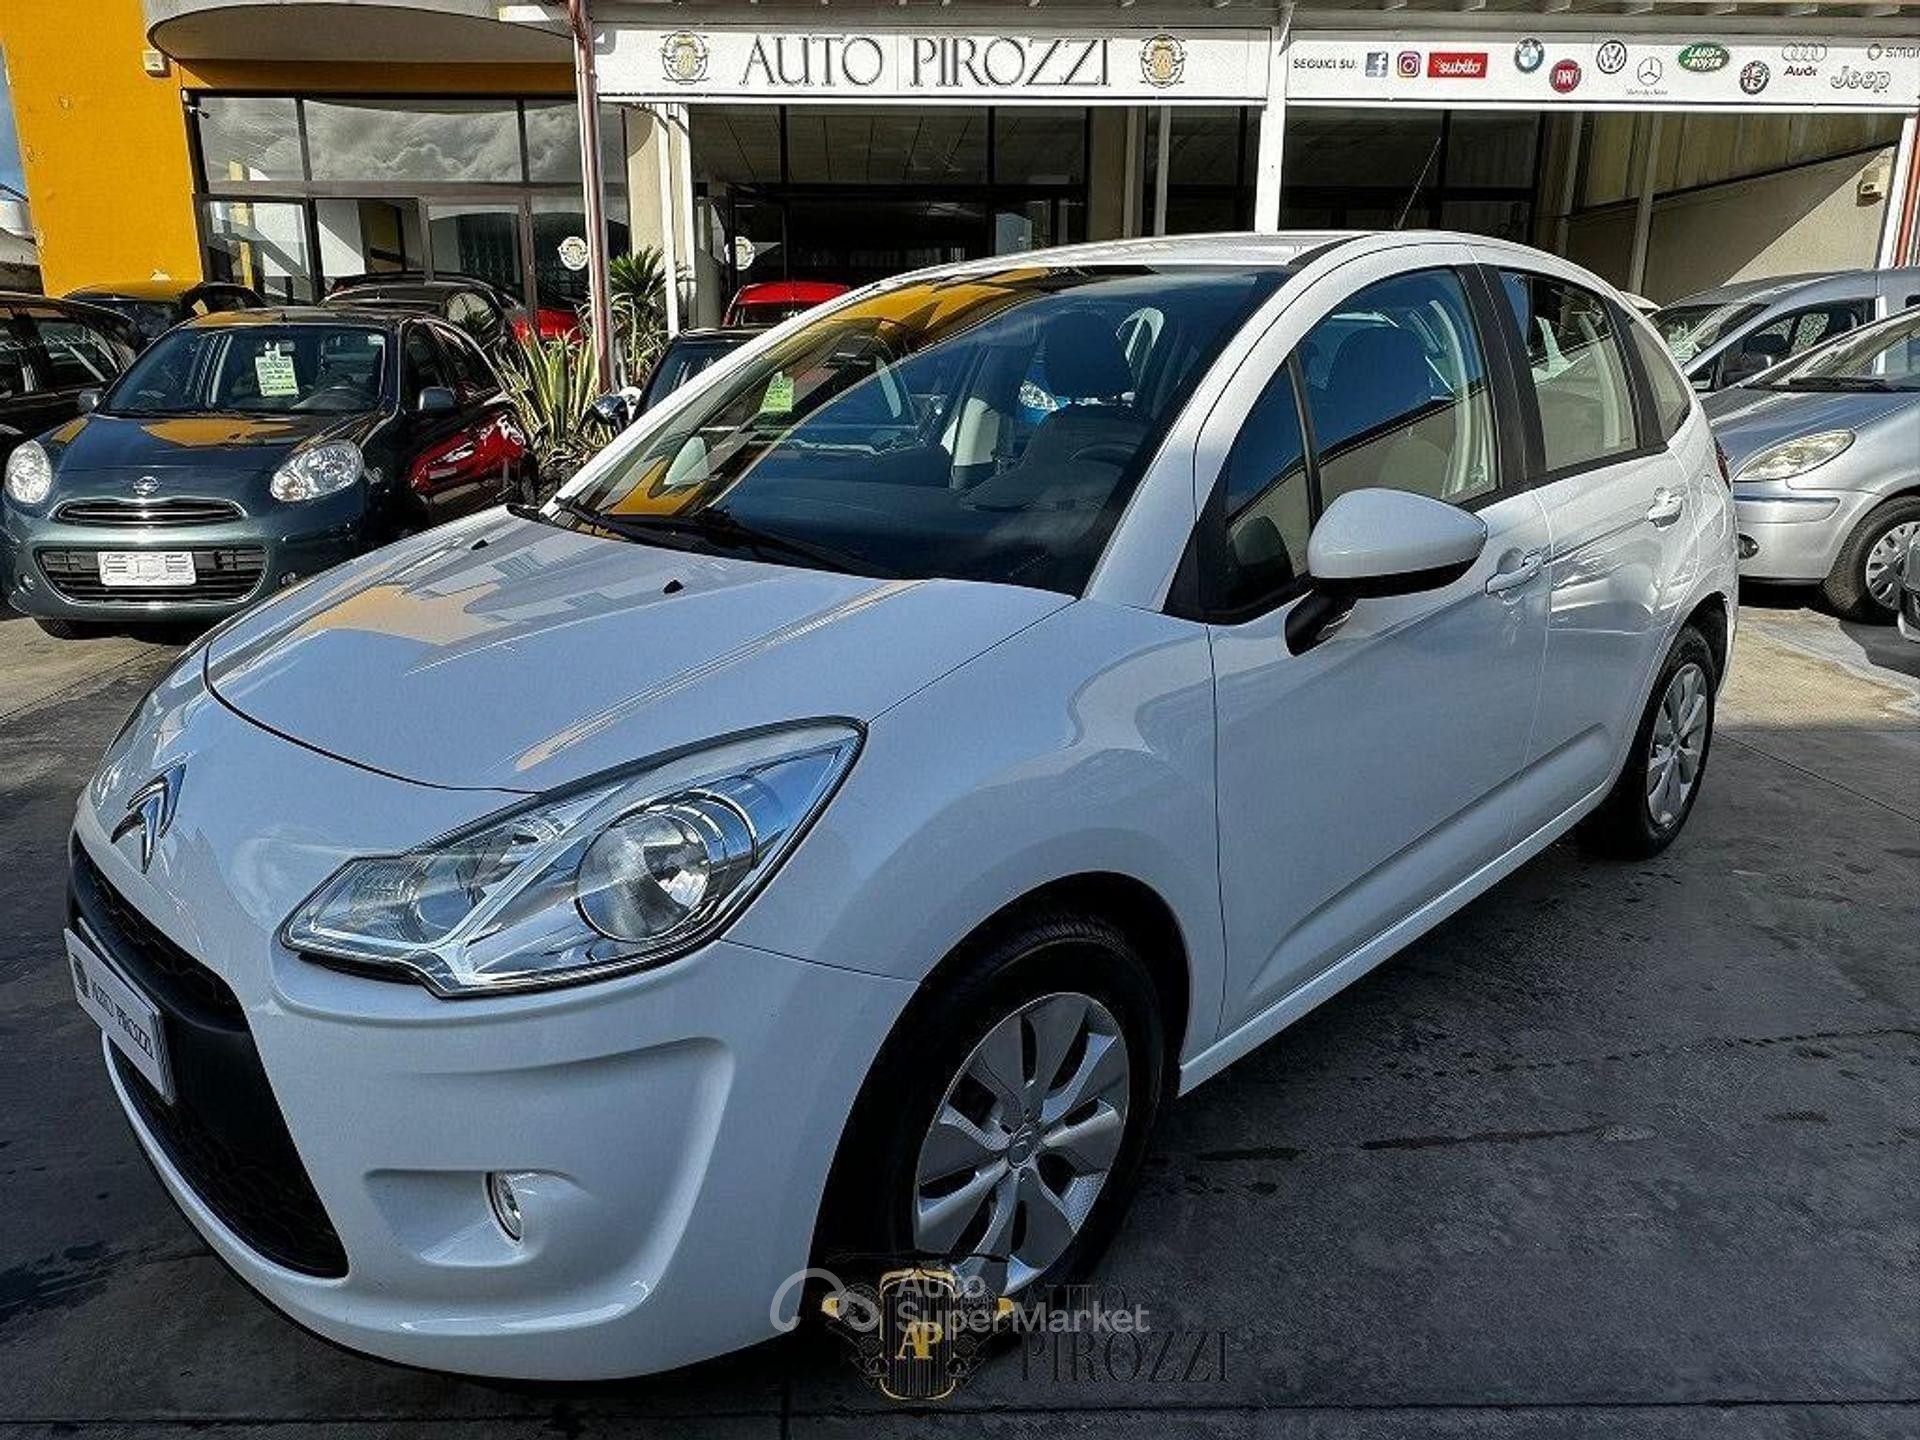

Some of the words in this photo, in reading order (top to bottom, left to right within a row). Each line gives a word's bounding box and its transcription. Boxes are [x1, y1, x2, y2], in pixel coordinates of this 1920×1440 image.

[740, 35, 882, 87] AUTO
[910, 37, 1110, 87] PIROZZI
[1293, 58, 1337, 69] SEGUICI
[1783, 65, 1818, 76] Audi
[1830, 65, 1891, 93] Jeep
